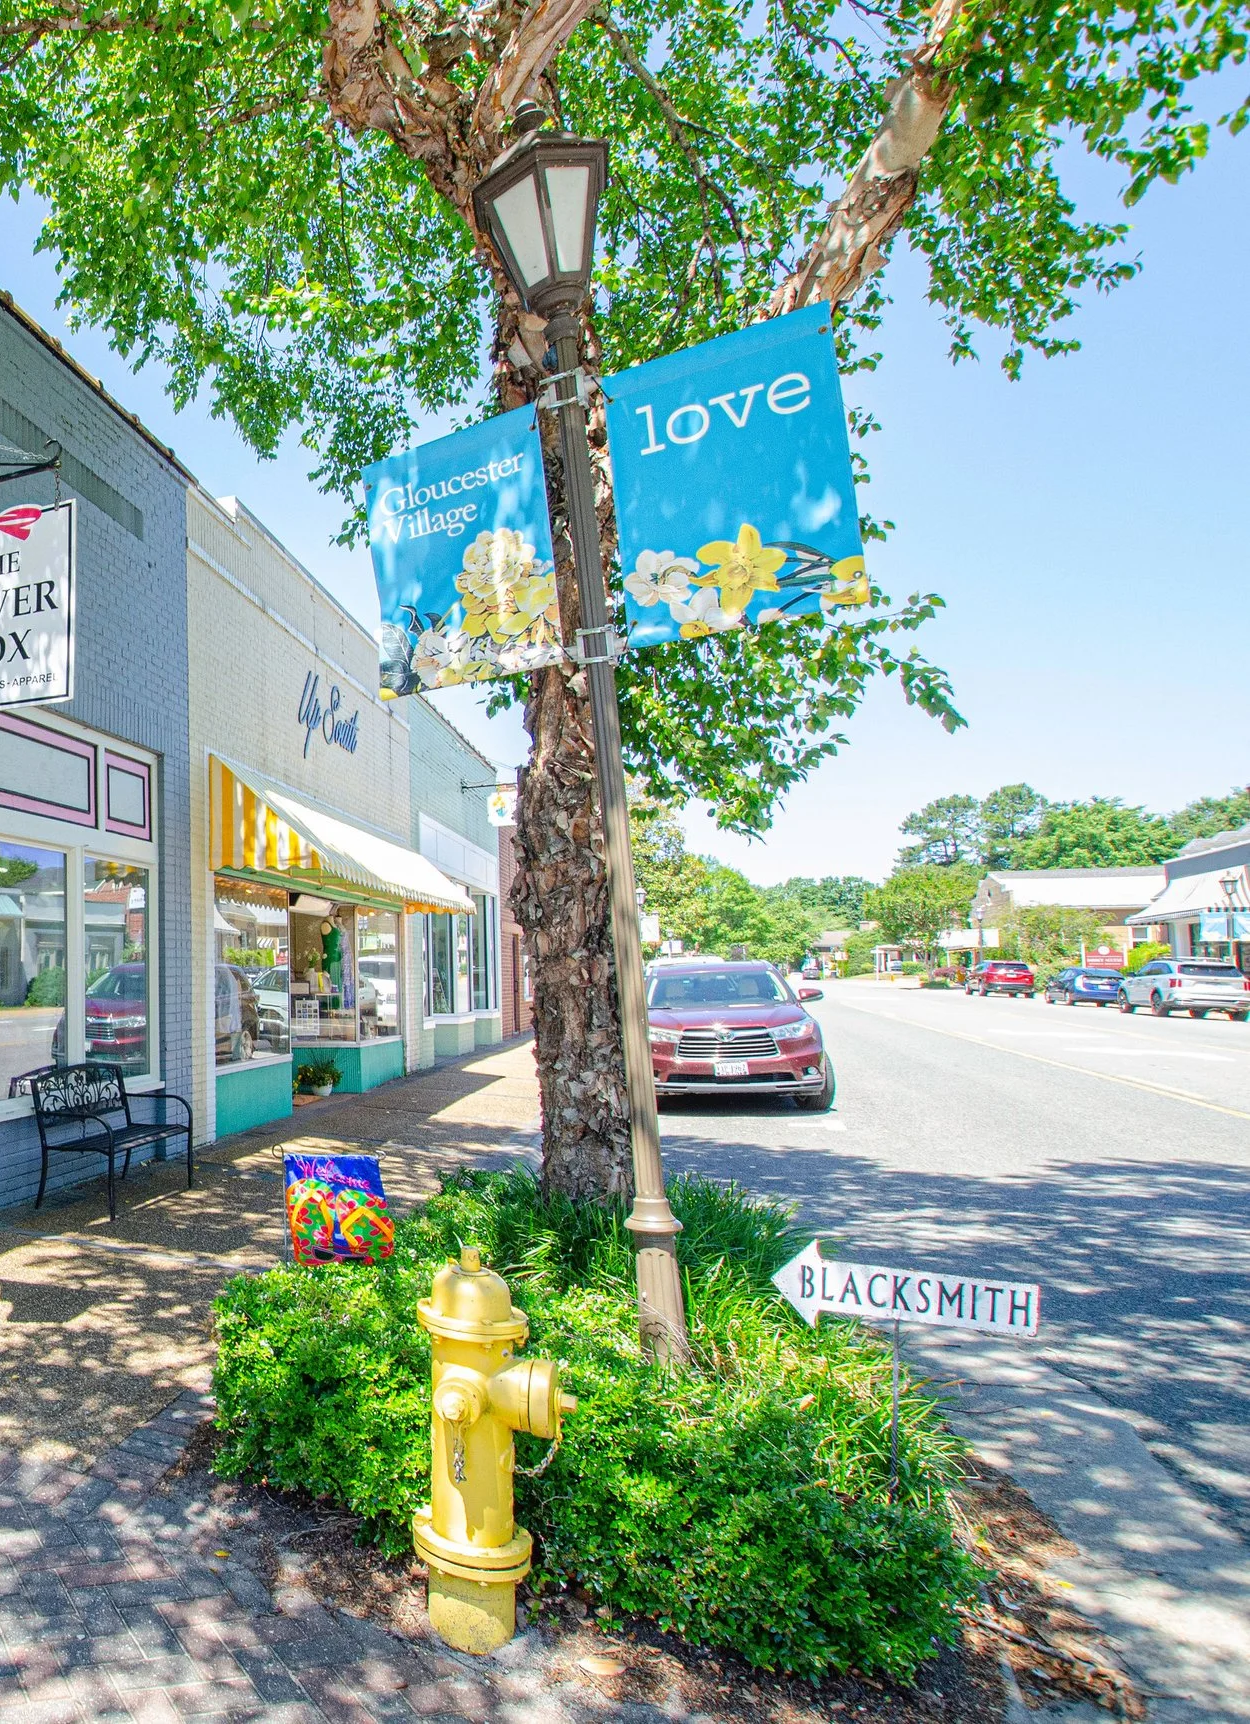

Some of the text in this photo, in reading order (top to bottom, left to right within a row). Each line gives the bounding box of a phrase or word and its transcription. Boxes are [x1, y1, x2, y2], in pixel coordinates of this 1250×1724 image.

[635, 372, 812, 456] love
[379, 452, 524, 517] Gloucester
[383, 503, 478, 544] Village
[12, 672, 57, 688] APPAREL
[298, 670, 359, 759] Up South
[296, 1159, 371, 1190] Welcome
[800, 1264, 1032, 1327] BLACKSMITH
